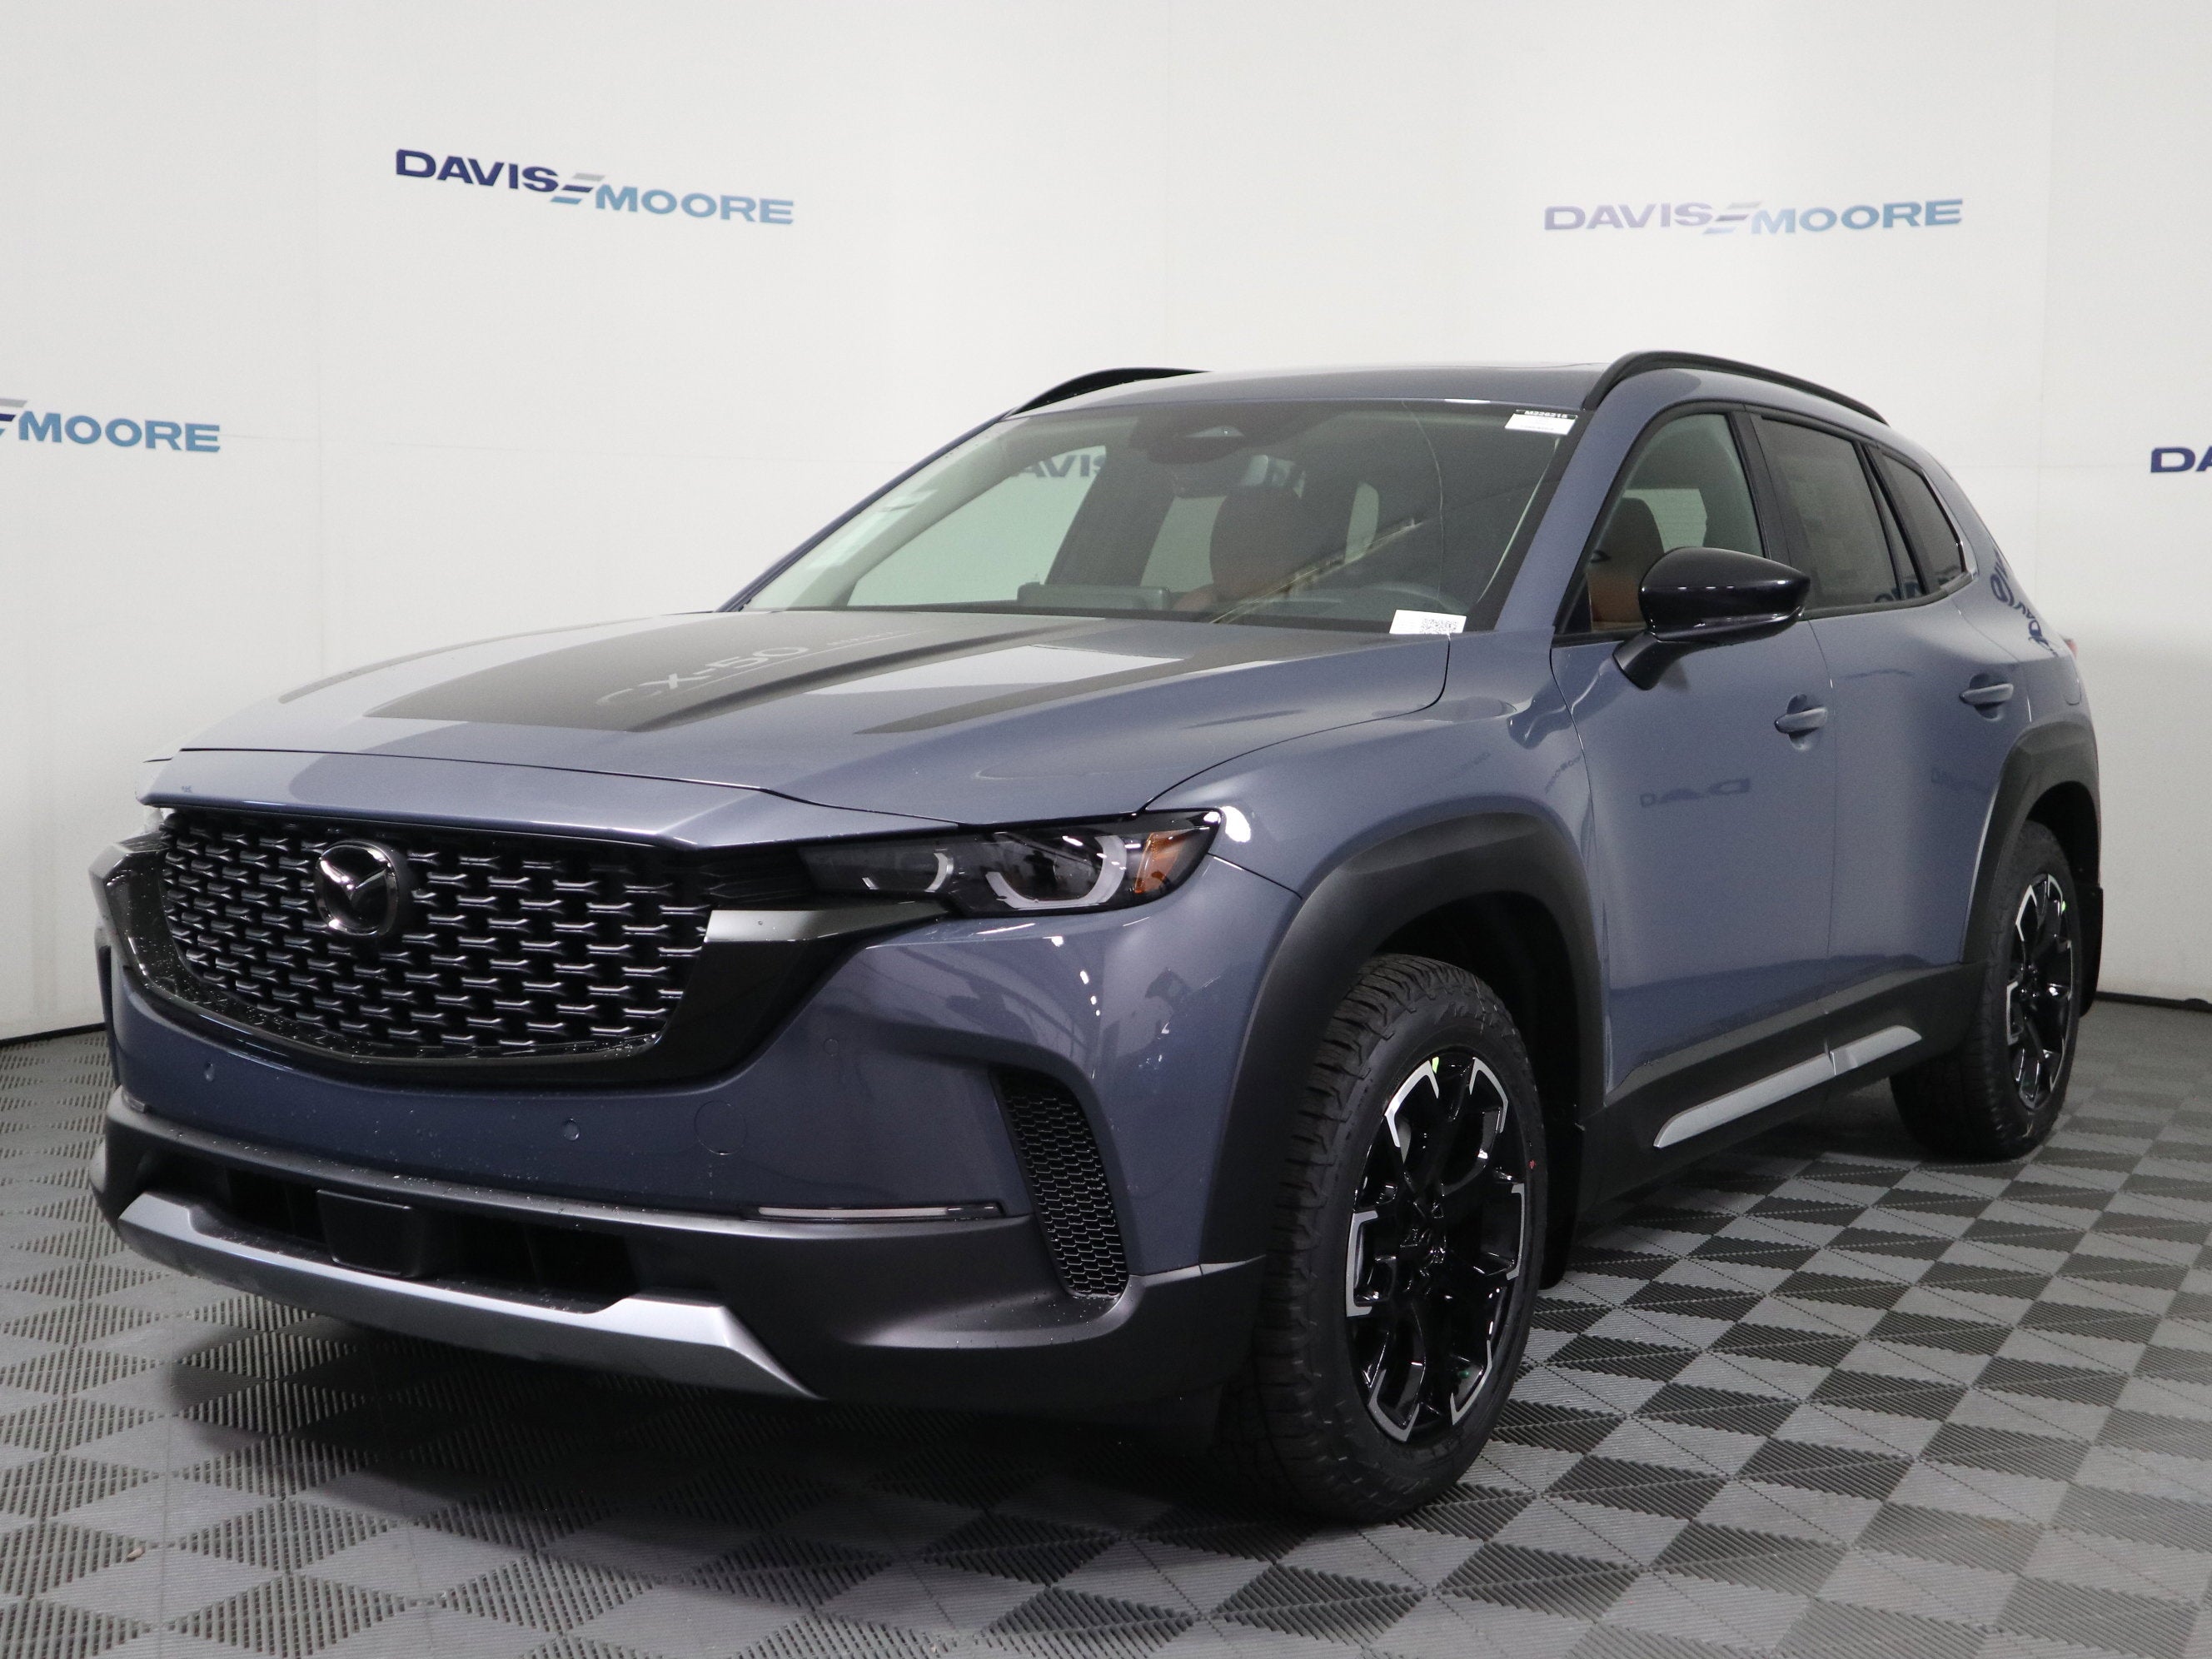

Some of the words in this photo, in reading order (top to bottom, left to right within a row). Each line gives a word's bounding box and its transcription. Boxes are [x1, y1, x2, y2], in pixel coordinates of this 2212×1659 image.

[396, 148, 559, 193] DAVIS
[595, 184, 794, 225] MOORE
[1544, 202, 1714, 231] DAVIS
[1751, 198, 1964, 235] MOORE
[18, 411, 221, 453] MOORE
